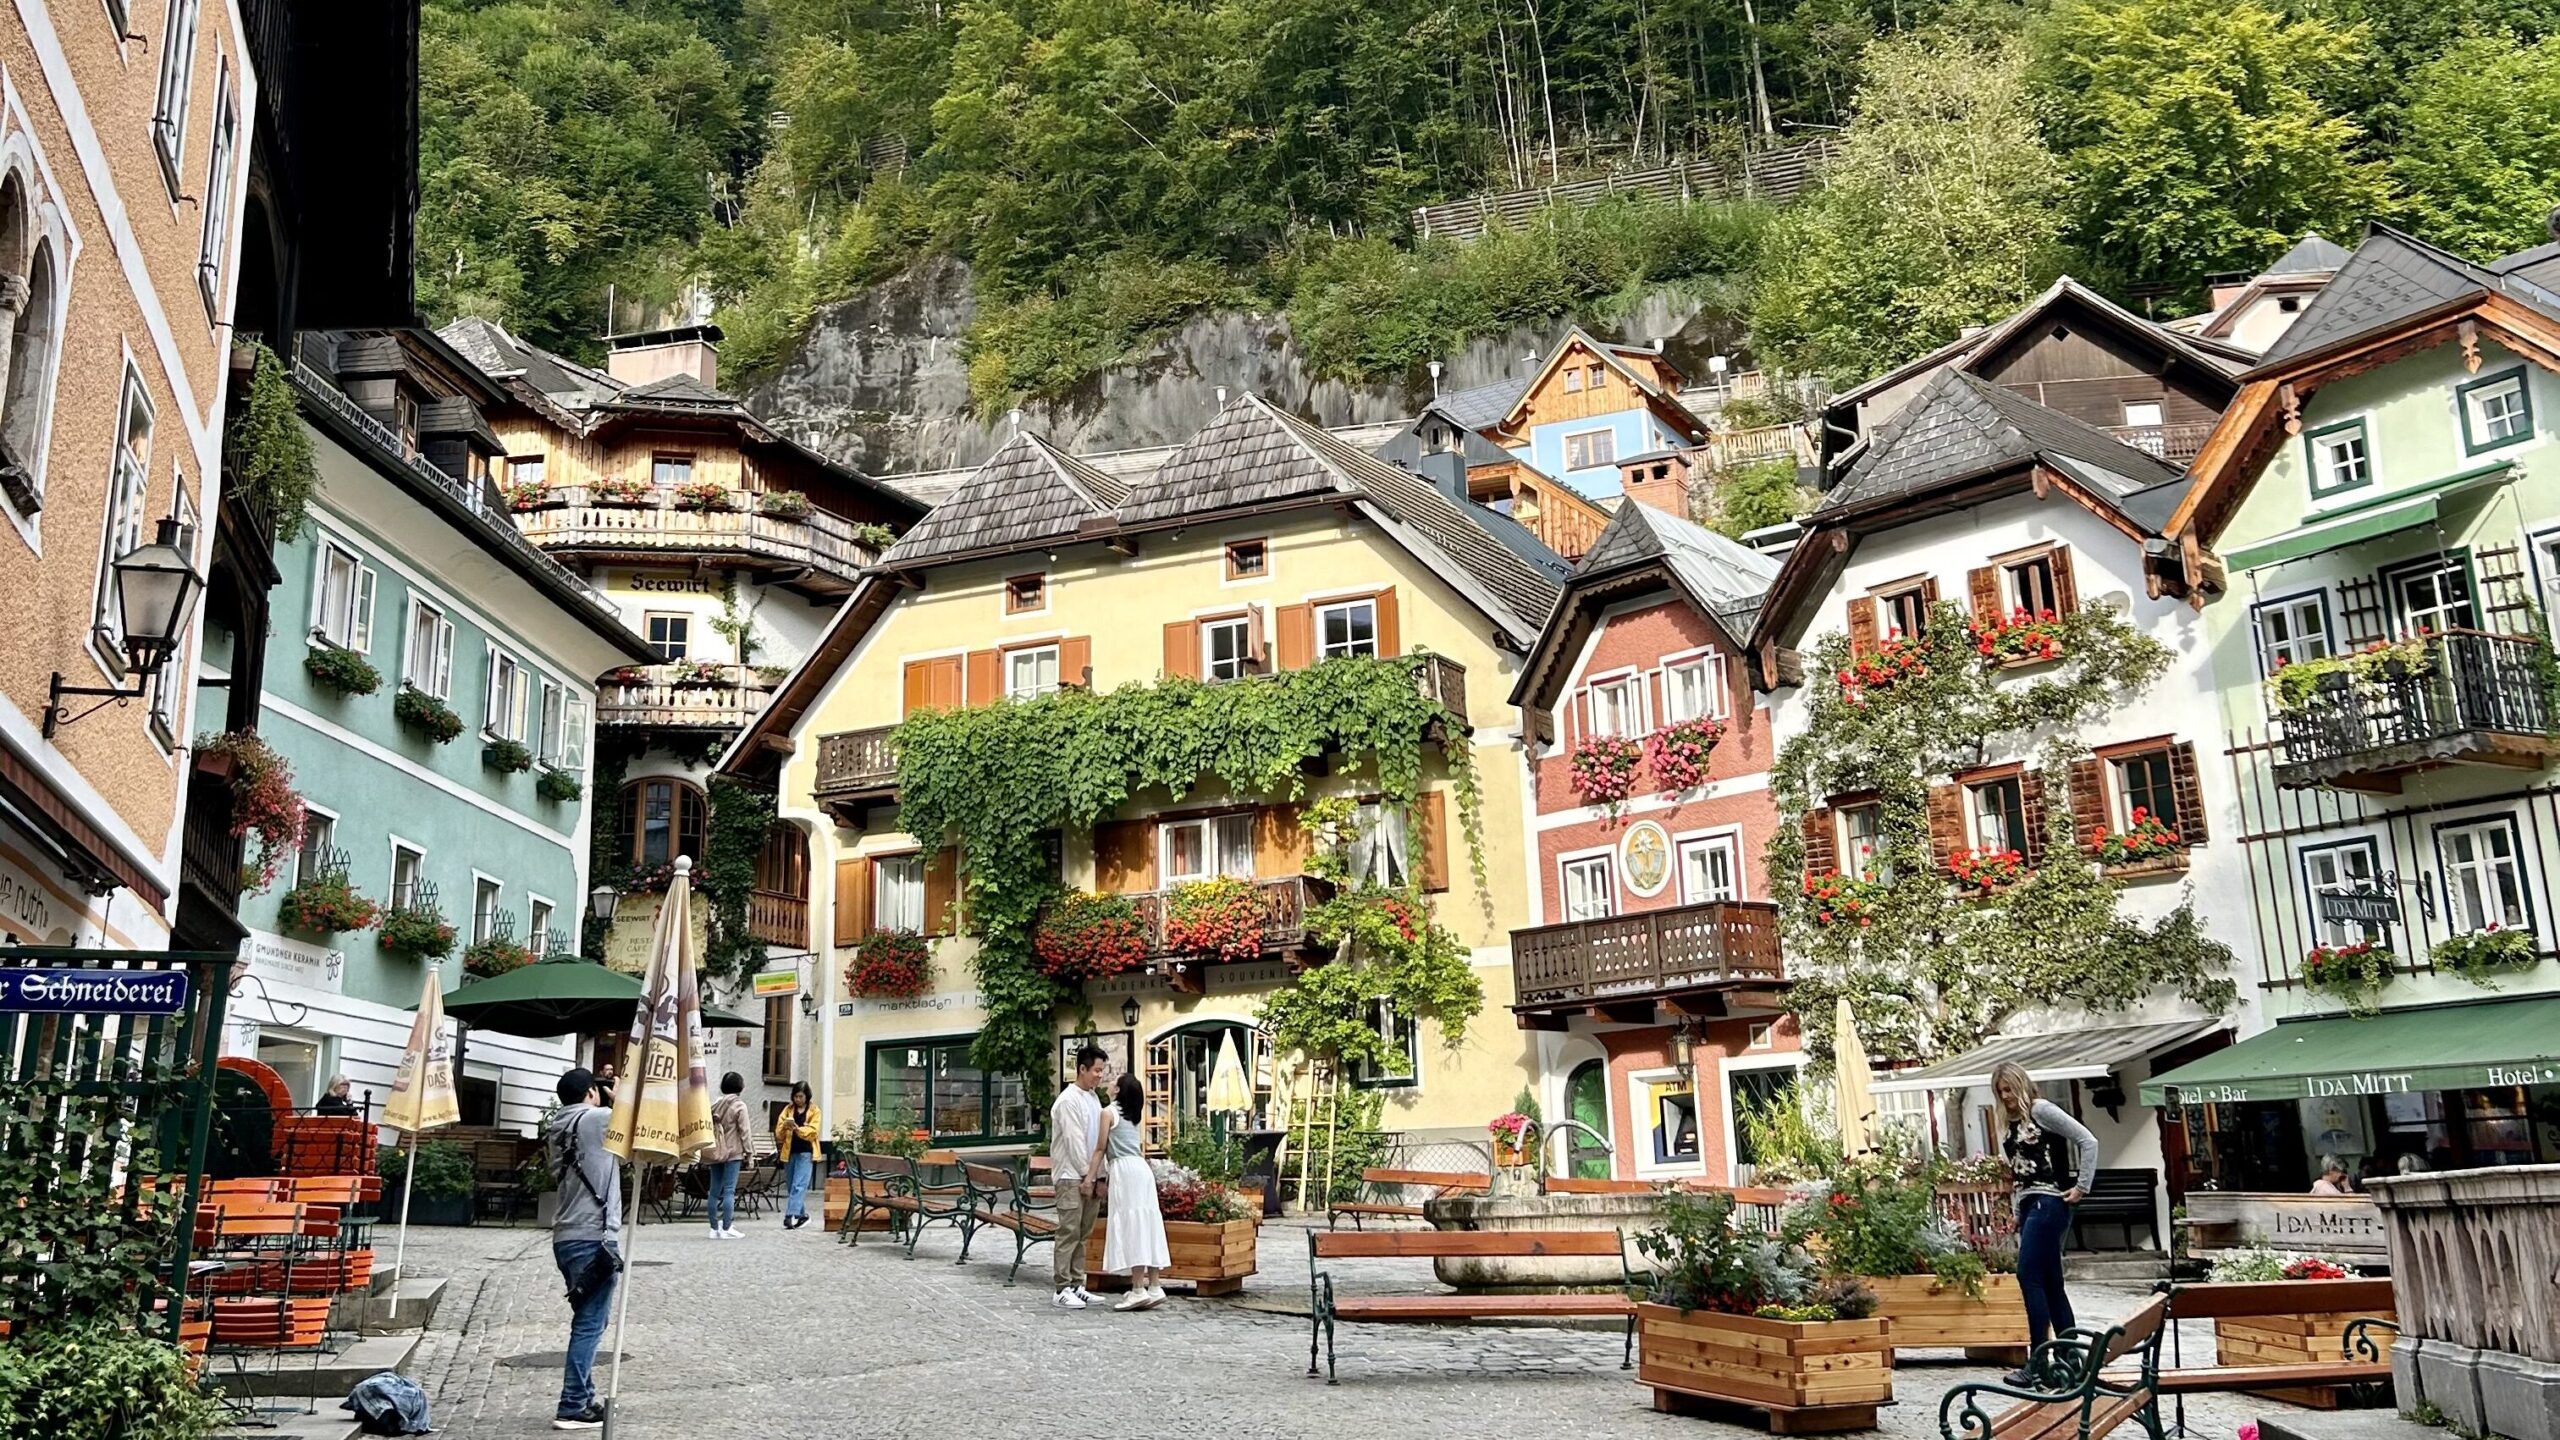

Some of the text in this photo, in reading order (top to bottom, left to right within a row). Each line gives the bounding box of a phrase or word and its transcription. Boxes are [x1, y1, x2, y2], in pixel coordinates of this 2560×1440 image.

[630, 573, 709, 593] Seewirt
[2323, 898, 2392, 919] IDA MITT
[255, 943, 321, 967] GMUNDNER KERAMIK
[20, 973, 175, 1007] Schneiderei
[1101, 978, 1165, 993] ANDENKE
[879, 998, 951, 1011] marktladen
[646, 1053, 677, 1080] IER.
[427, 1071, 447, 1088] DAS
[1665, 1081, 1688, 1092] ATM
[2219, 1085, 2248, 1102] Bar
[2307, 1077, 2347, 1097] IDA
[2351, 1072, 2413, 1096] MITT
[2486, 1065, 2540, 1087] Hotel
[2276, 1212, 2373, 1235] IDA MITT
